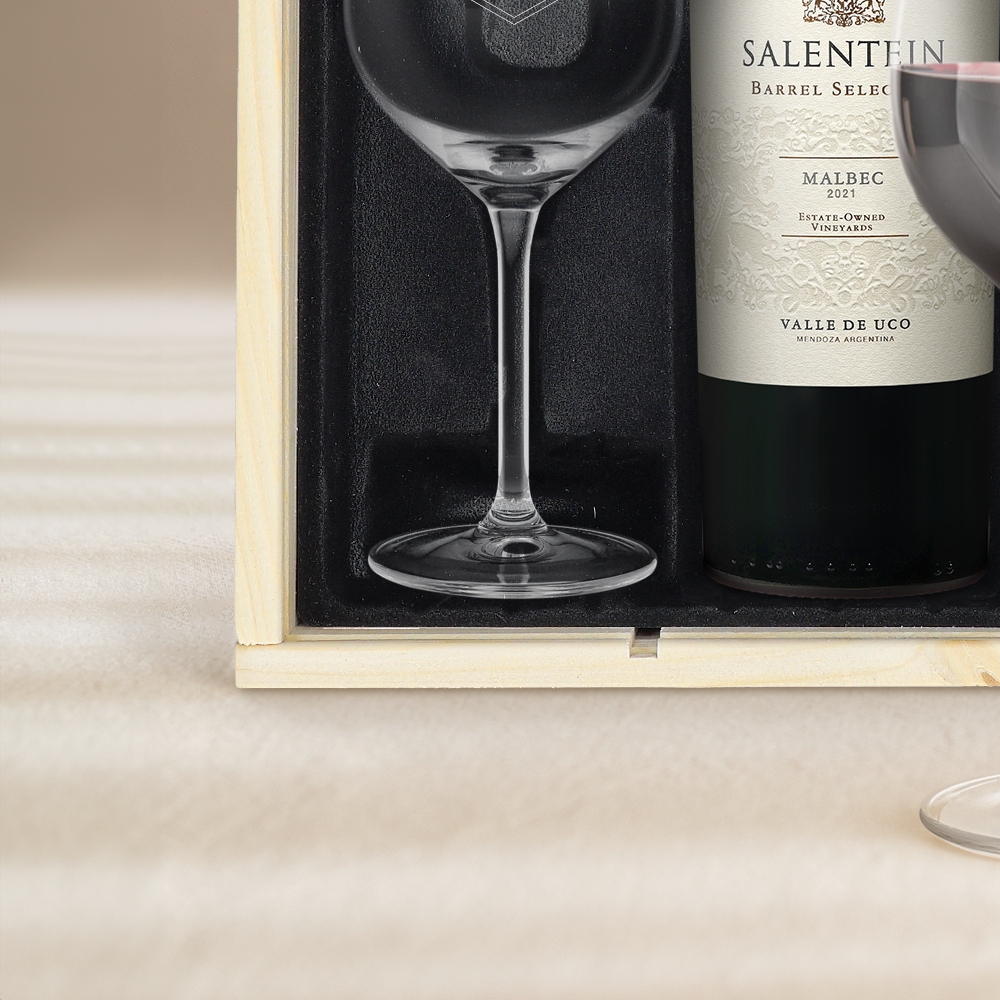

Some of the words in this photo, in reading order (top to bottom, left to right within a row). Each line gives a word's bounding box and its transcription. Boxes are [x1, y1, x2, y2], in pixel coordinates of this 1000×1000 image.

[742, 39, 945, 68] SALENTEIN
[802, 171, 884, 185] MALBEC
[827, 189, 855, 198] 2021
[780, 318, 836, 331] VALLE
[843, 319, 867, 331] DE
[874, 318, 911, 331] UCO
[844, 335, 895, 343] ARGENTINA
